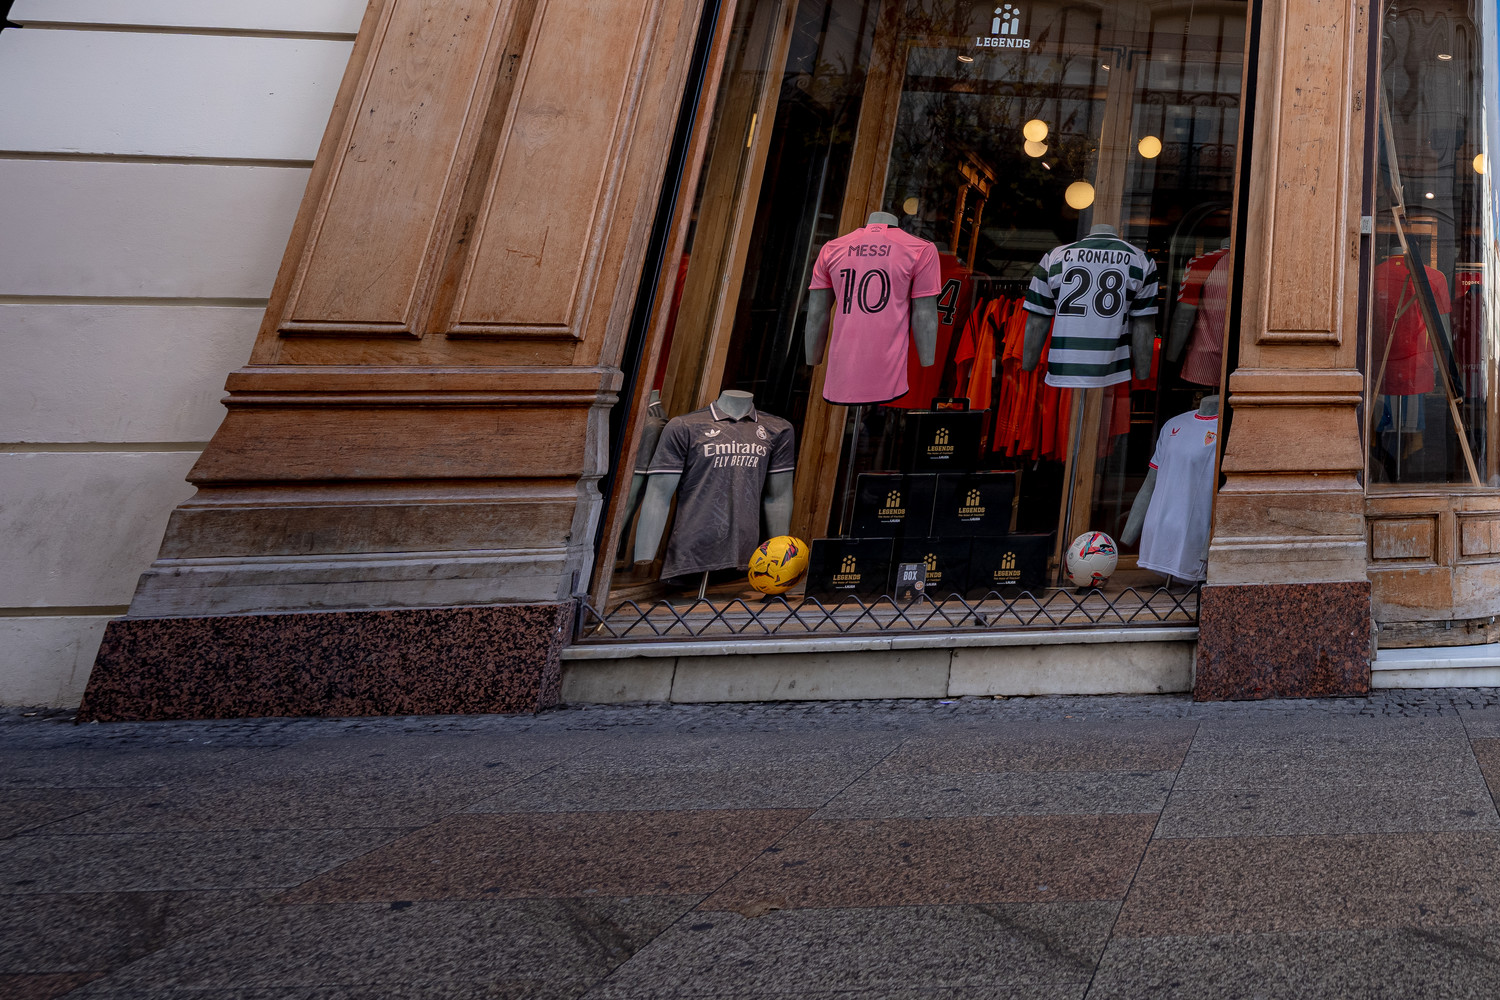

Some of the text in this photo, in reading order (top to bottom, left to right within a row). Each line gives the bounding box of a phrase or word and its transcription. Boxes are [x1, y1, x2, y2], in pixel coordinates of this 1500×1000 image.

[975, 37, 1031, 49] LEGENDS
[848, 244, 891, 257] MESSI
[1064, 249, 1131, 265] C. RONALDO
[840, 267, 891, 314] 10
[1057, 266, 1125, 318] 28
[703, 440, 767, 457] Emirates
[713, 455, 759, 468] FLY BETTER
[903, 570, 918, 581] BOX
